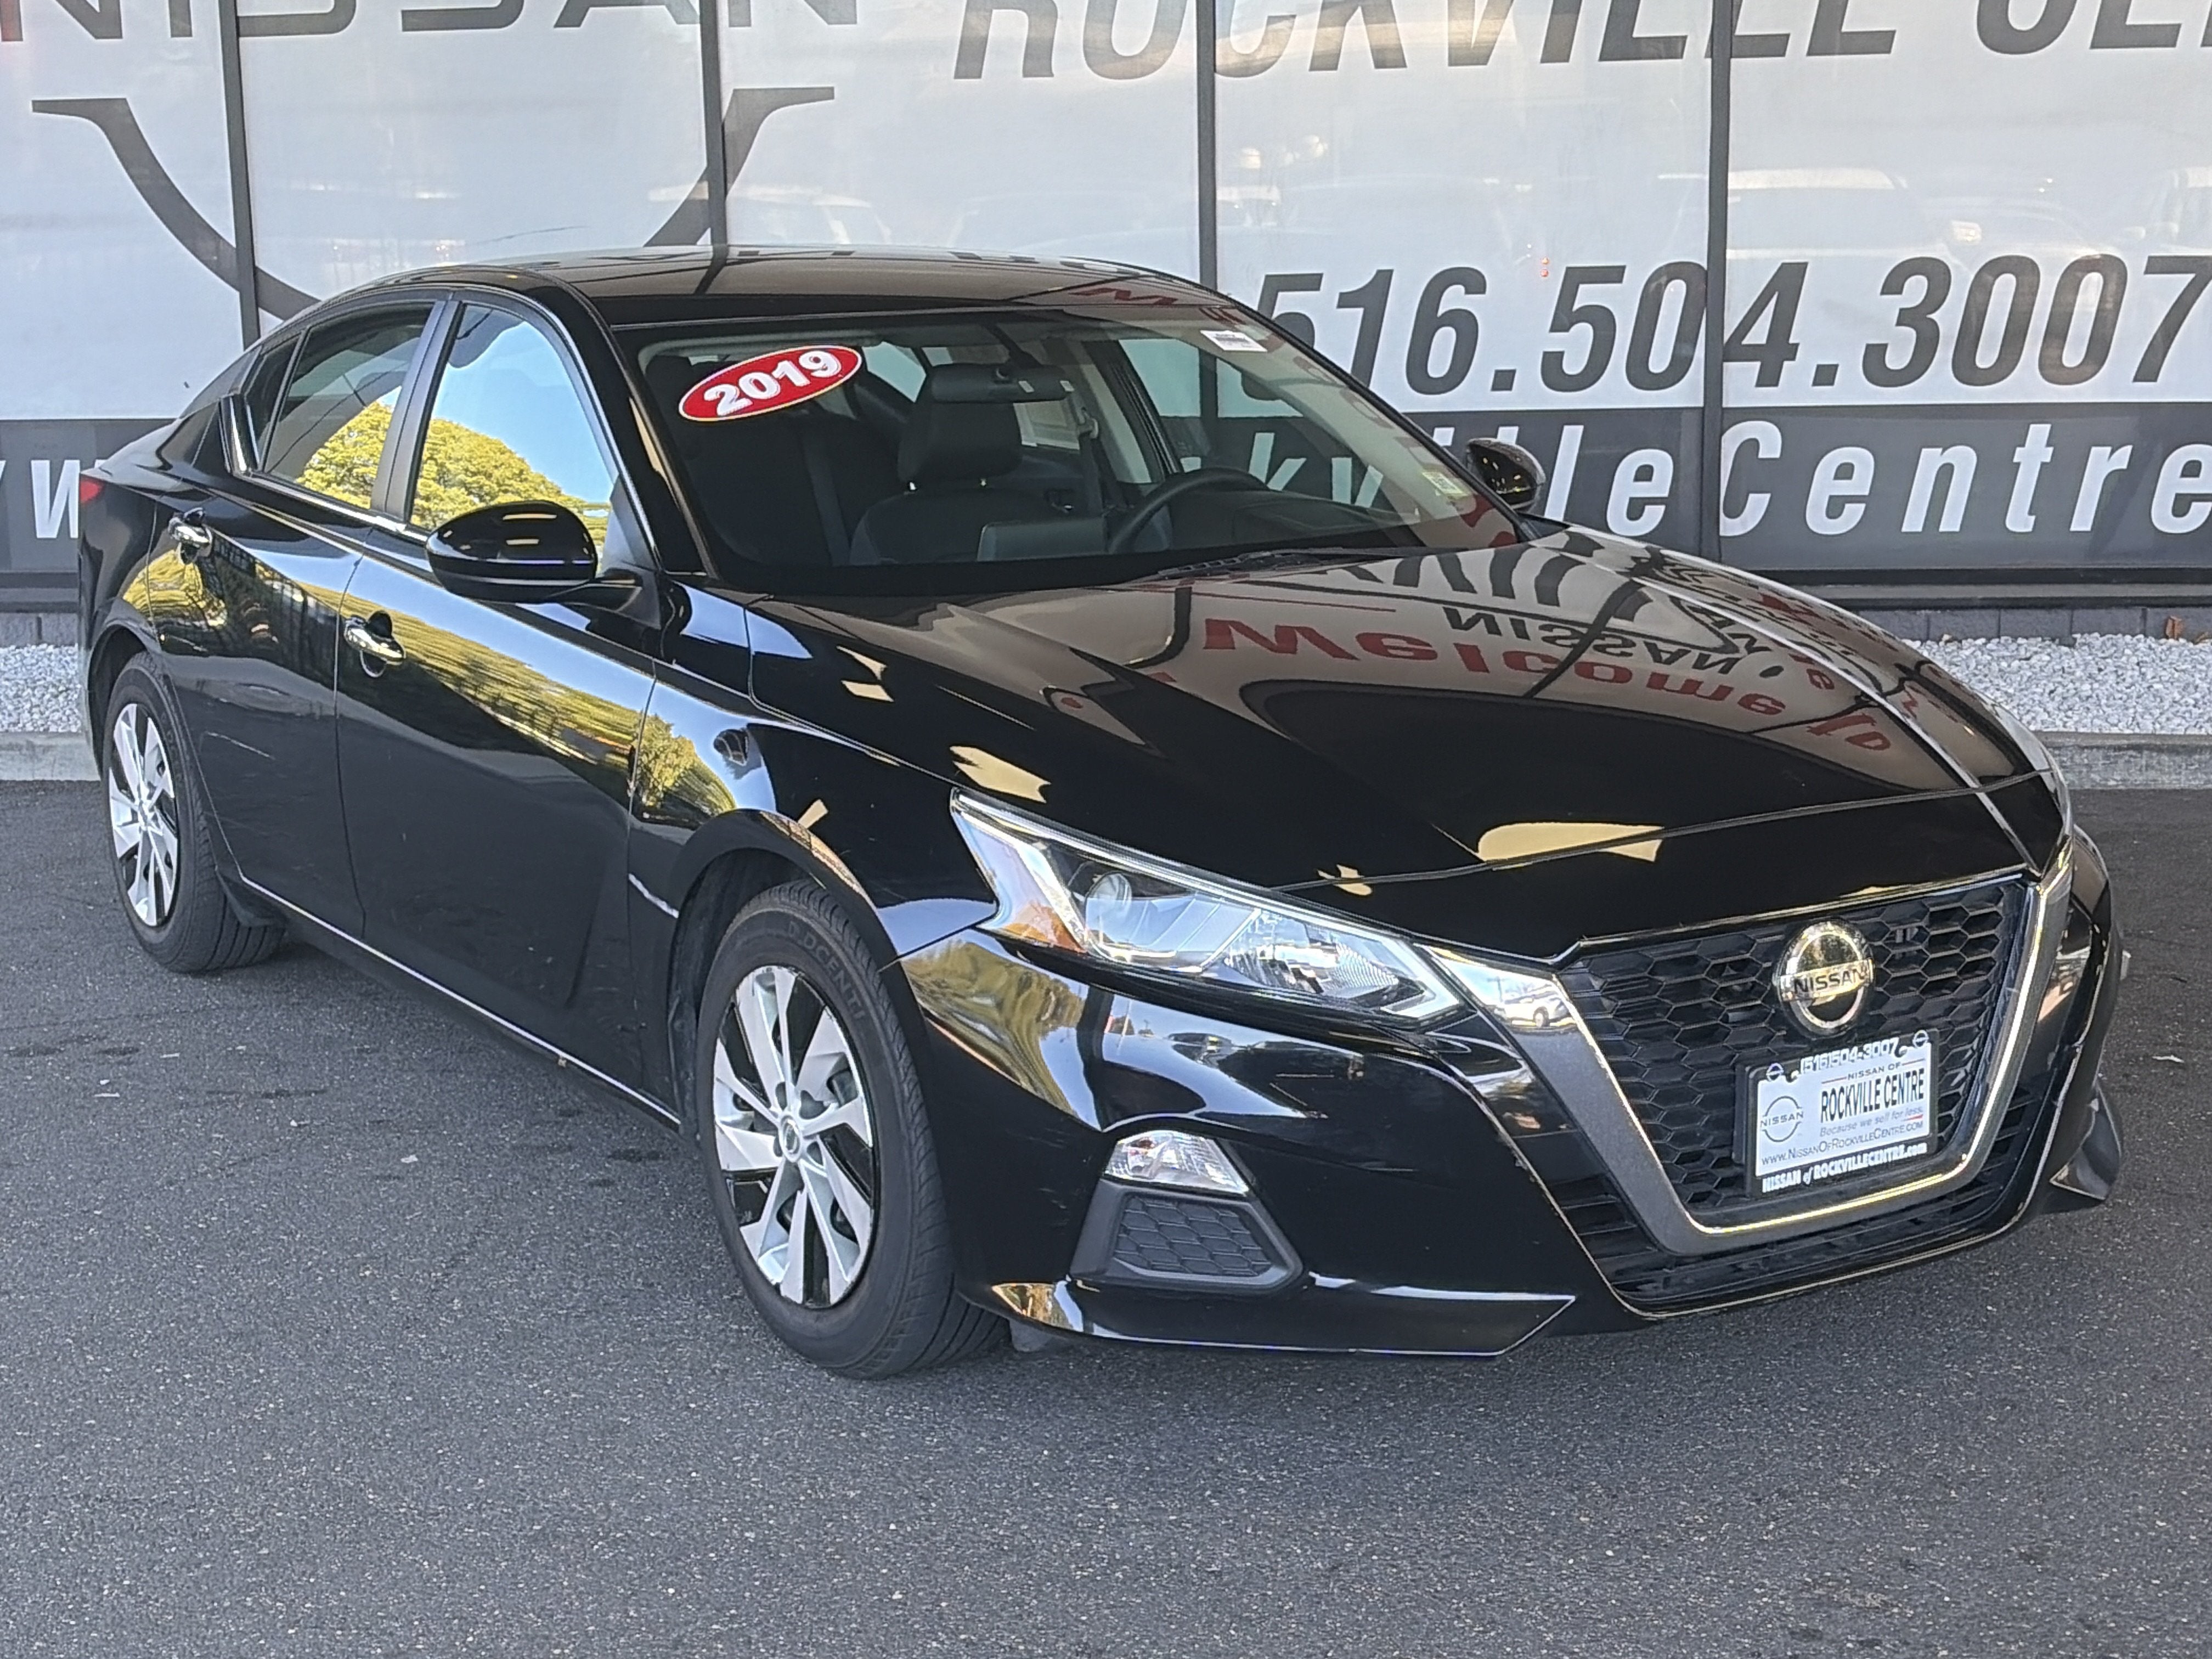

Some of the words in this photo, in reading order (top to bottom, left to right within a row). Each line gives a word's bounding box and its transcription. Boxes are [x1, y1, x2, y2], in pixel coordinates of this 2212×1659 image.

[703, 349, 841, 416] 2019
[1793, 968, 1865, 993] NISSAN
[1848, 1066, 1885, 1080] NISSAN
[1887, 1062, 1901, 1073] OF
[1821, 1077, 1882, 1122] ROCKVILLE
[1884, 1068, 1925, 1108] CENTRE
[1760, 1111, 1804, 1127] NISSAN
[1820, 1124, 1857, 1137] Because
[1762, 1169, 1802, 1193] NISSAN
